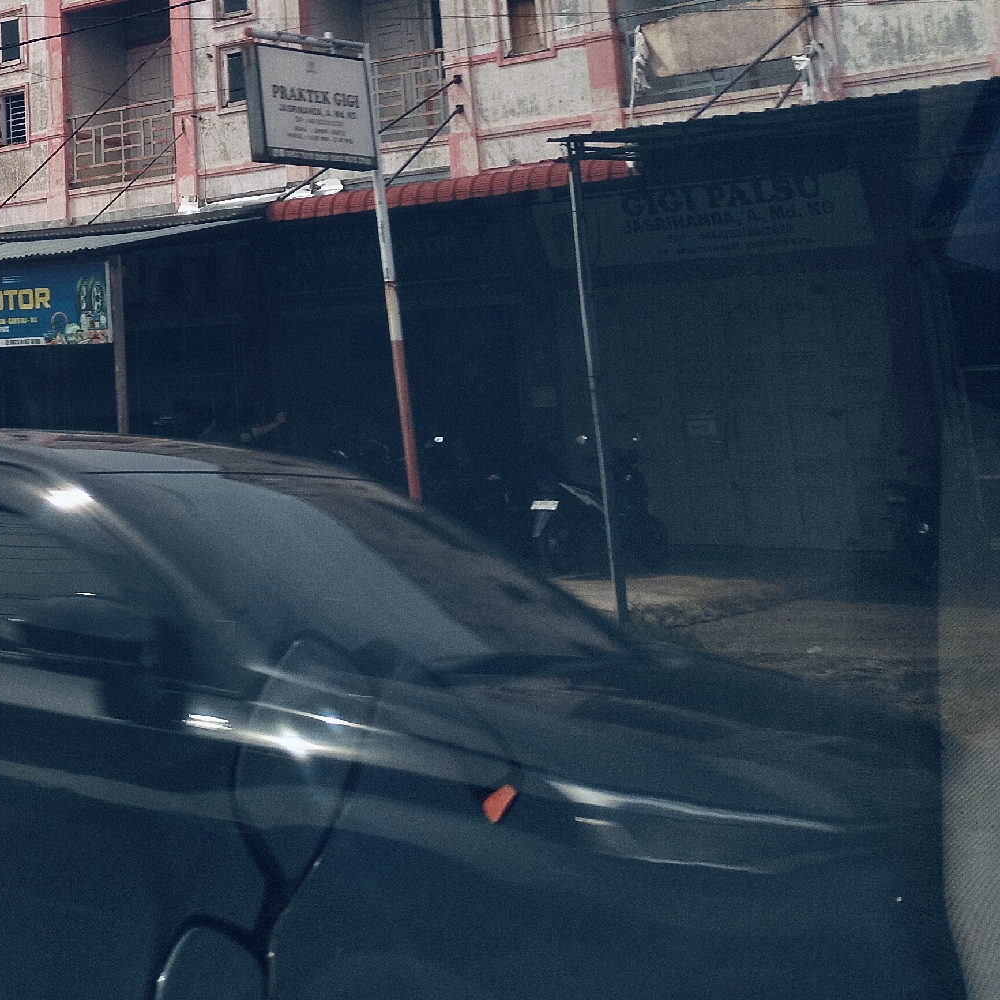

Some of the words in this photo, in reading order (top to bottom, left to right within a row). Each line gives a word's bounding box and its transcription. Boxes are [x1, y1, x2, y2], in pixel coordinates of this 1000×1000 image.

[271, 84, 331, 104] PRAKTEK
[333, 92, 360, 108] GIGI
[620, 183, 698, 217] GIGI
[704, 174, 820, 210] PALSU
